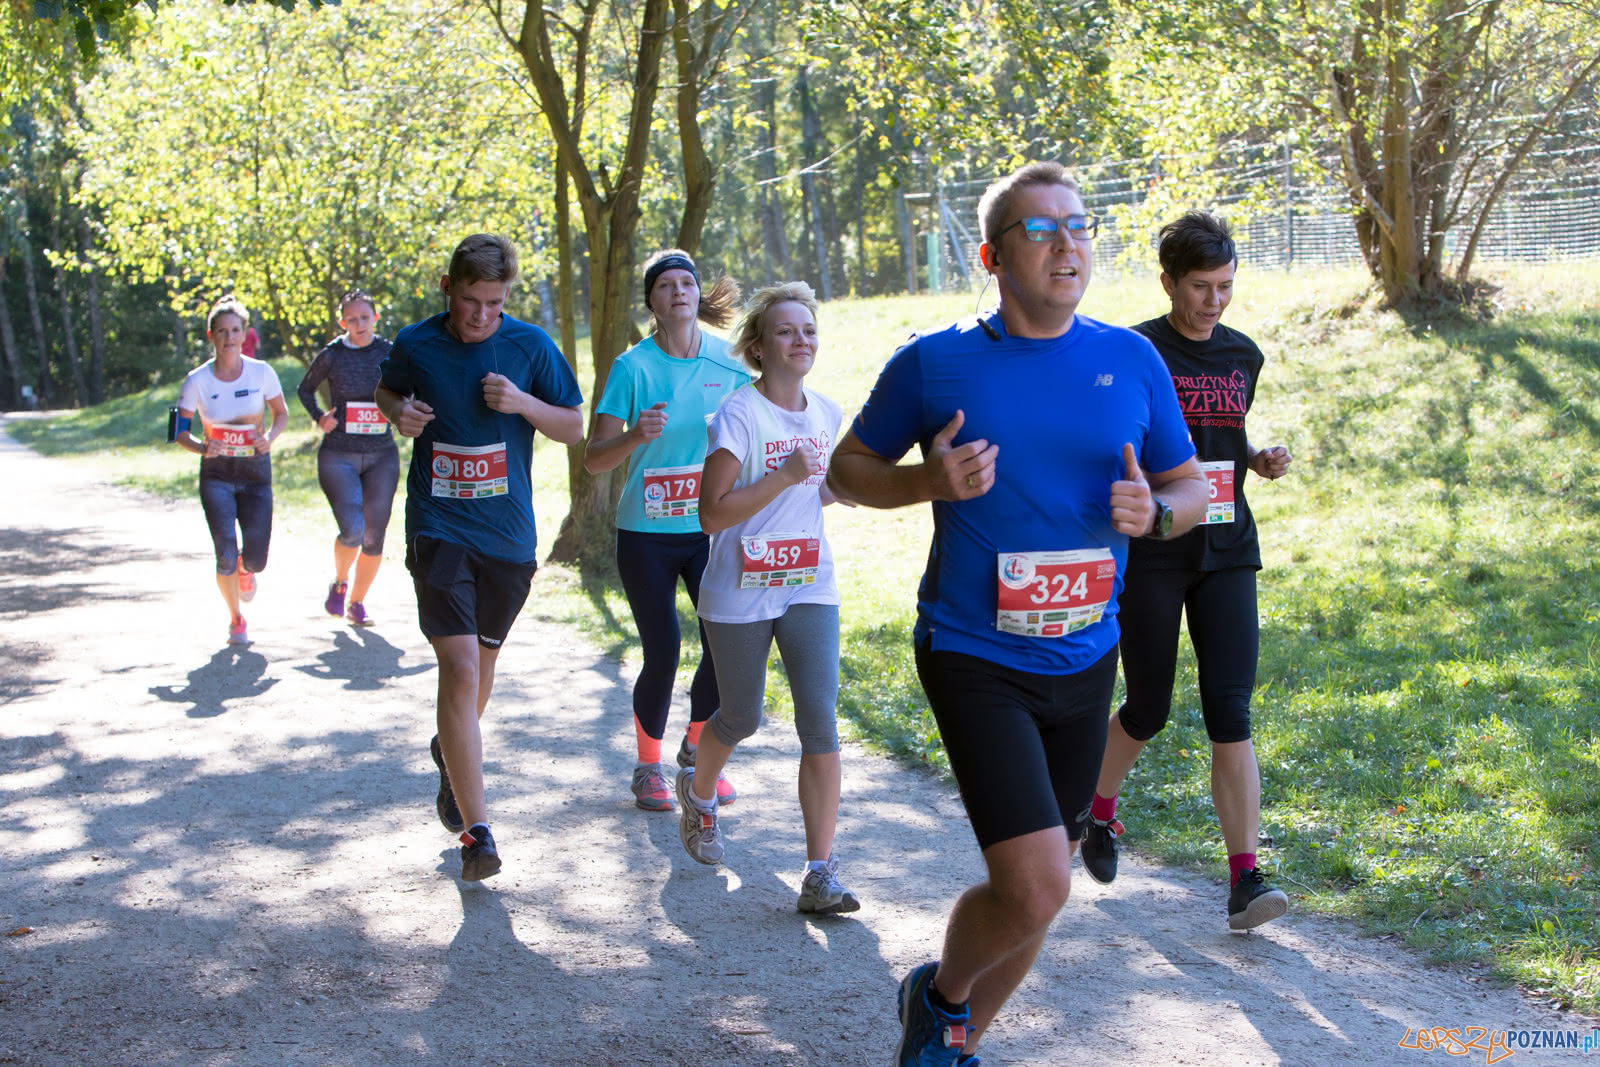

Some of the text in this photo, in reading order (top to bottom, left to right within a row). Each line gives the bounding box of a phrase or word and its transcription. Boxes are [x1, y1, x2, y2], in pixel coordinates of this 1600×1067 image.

[1172, 373, 1238, 390] DRUŻYNA
[1177, 389, 1247, 413] SZPIKU
[357, 410, 379, 421] 305
[223, 432, 245, 444] 306
[453, 459, 489, 478] 180
[663, 478, 697, 498] 179
[763, 545, 802, 567] 459
[1030, 571, 1089, 604] 324
